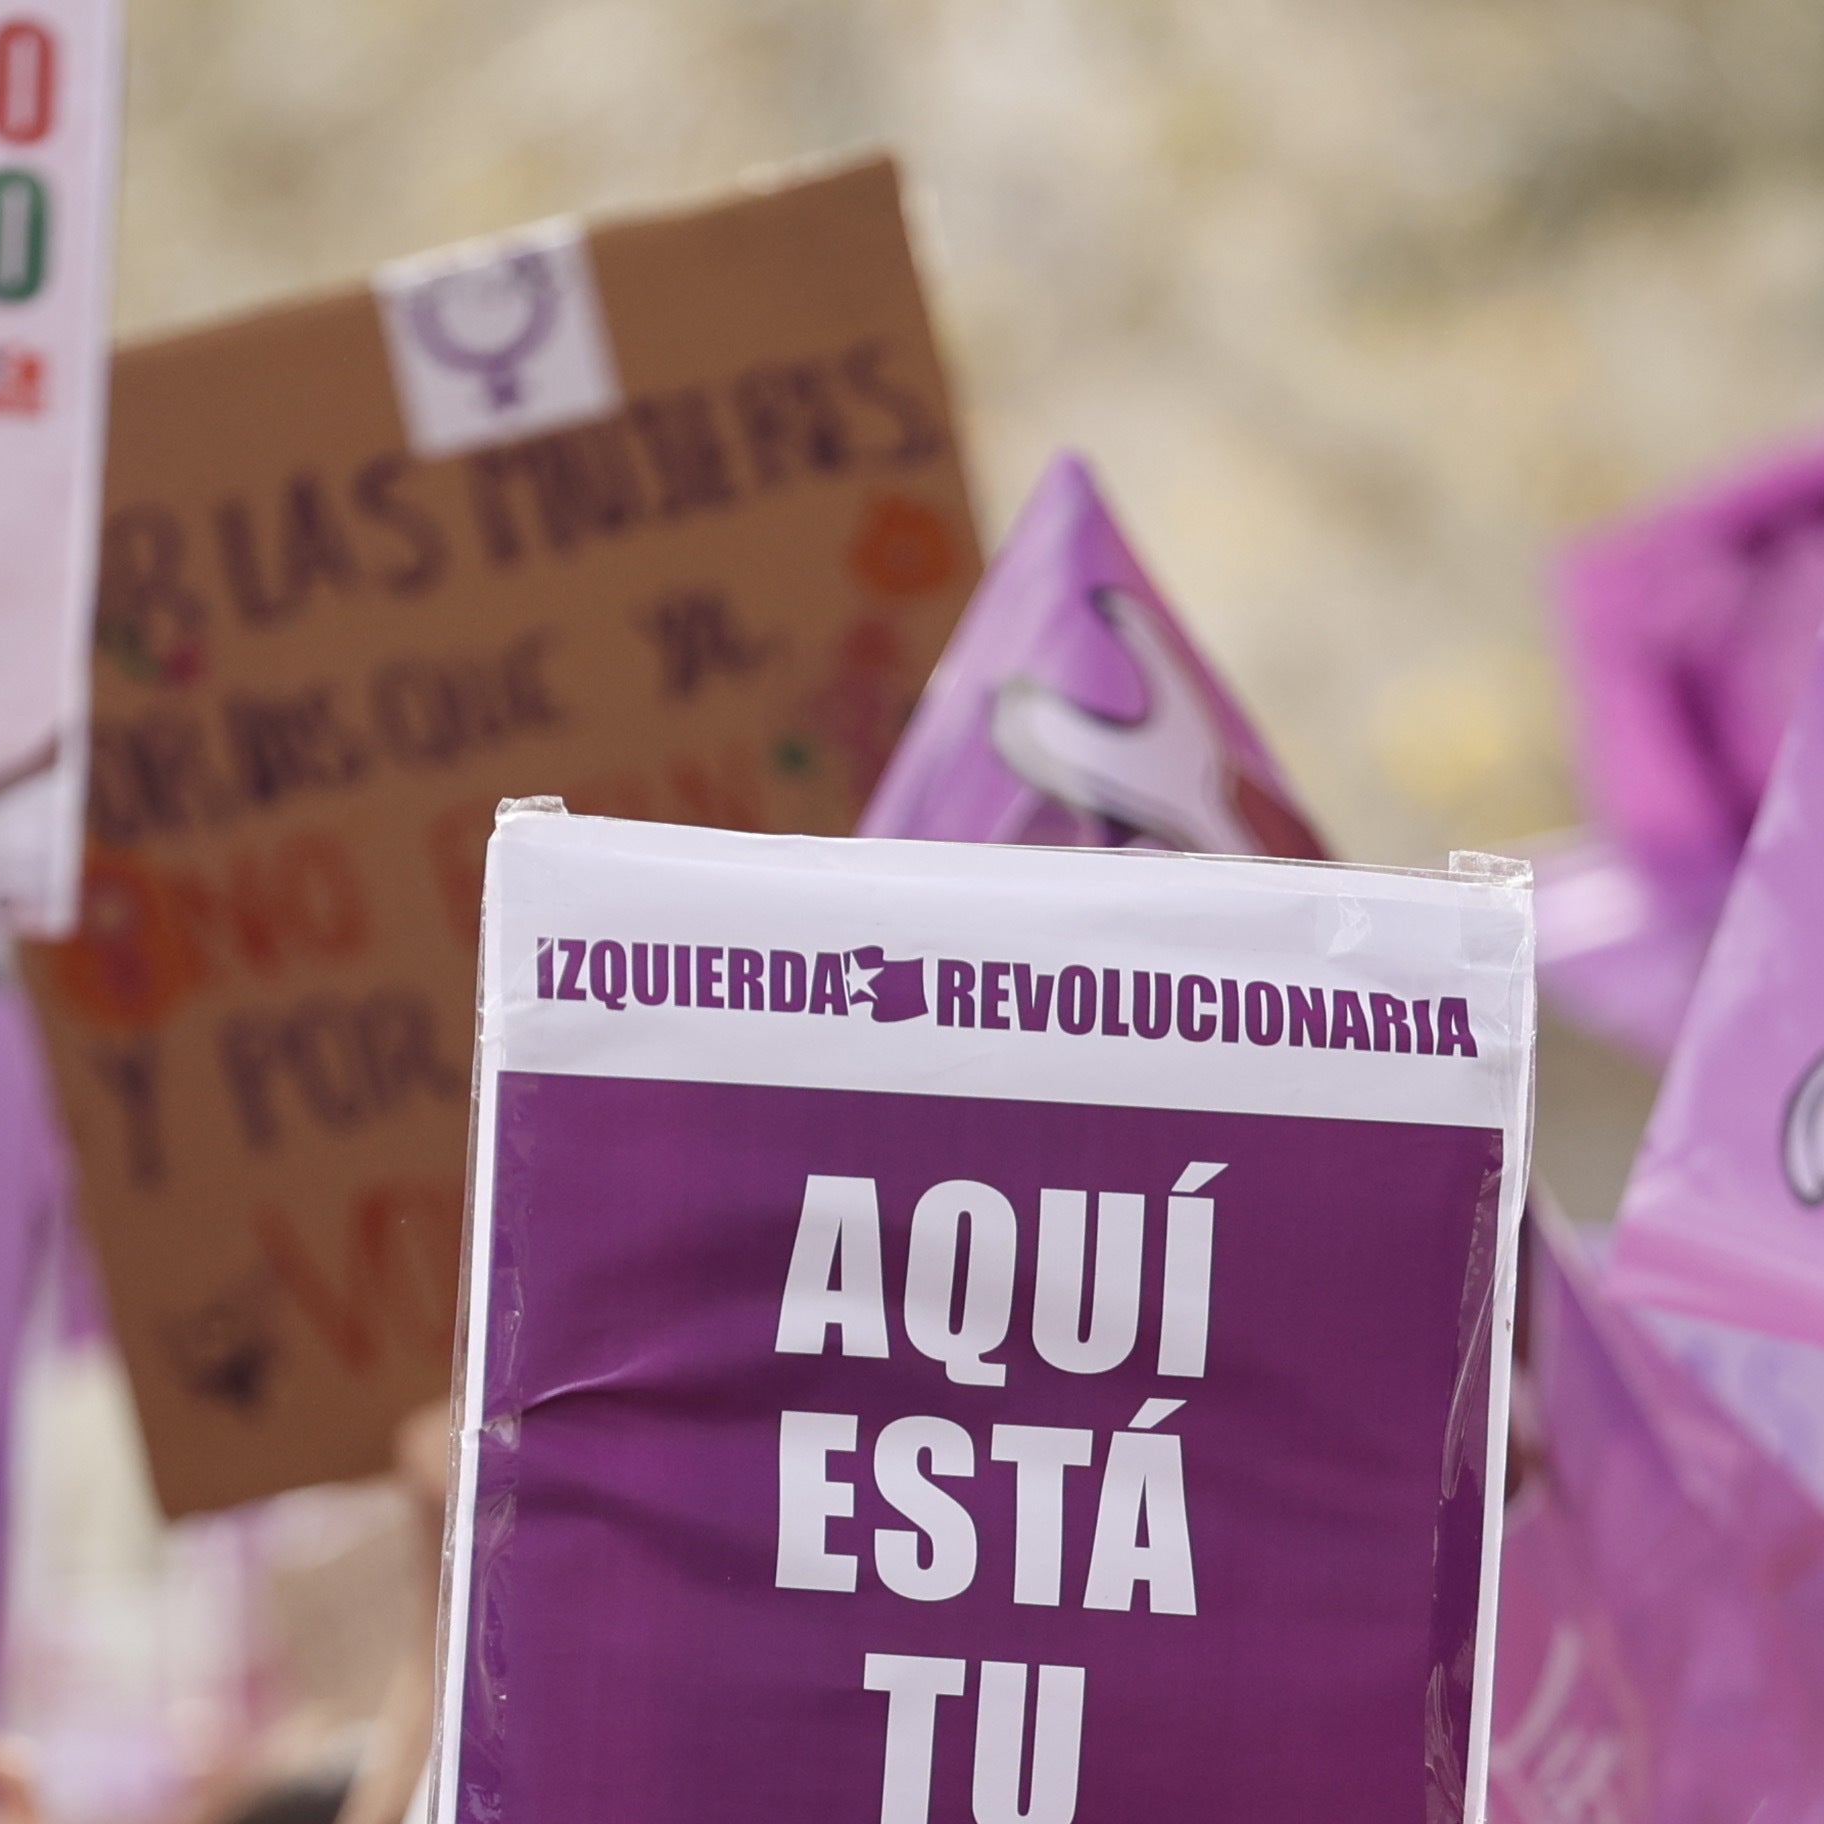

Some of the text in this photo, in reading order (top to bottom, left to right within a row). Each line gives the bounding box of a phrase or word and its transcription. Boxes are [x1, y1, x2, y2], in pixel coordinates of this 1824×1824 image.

[535, 935, 1479, 1060] IZQUIERDA REVOLUCIONARIA
[775, 1161, 1229, 1388] AQUÍ
[775, 1397, 1197, 1617] ESTÁ
